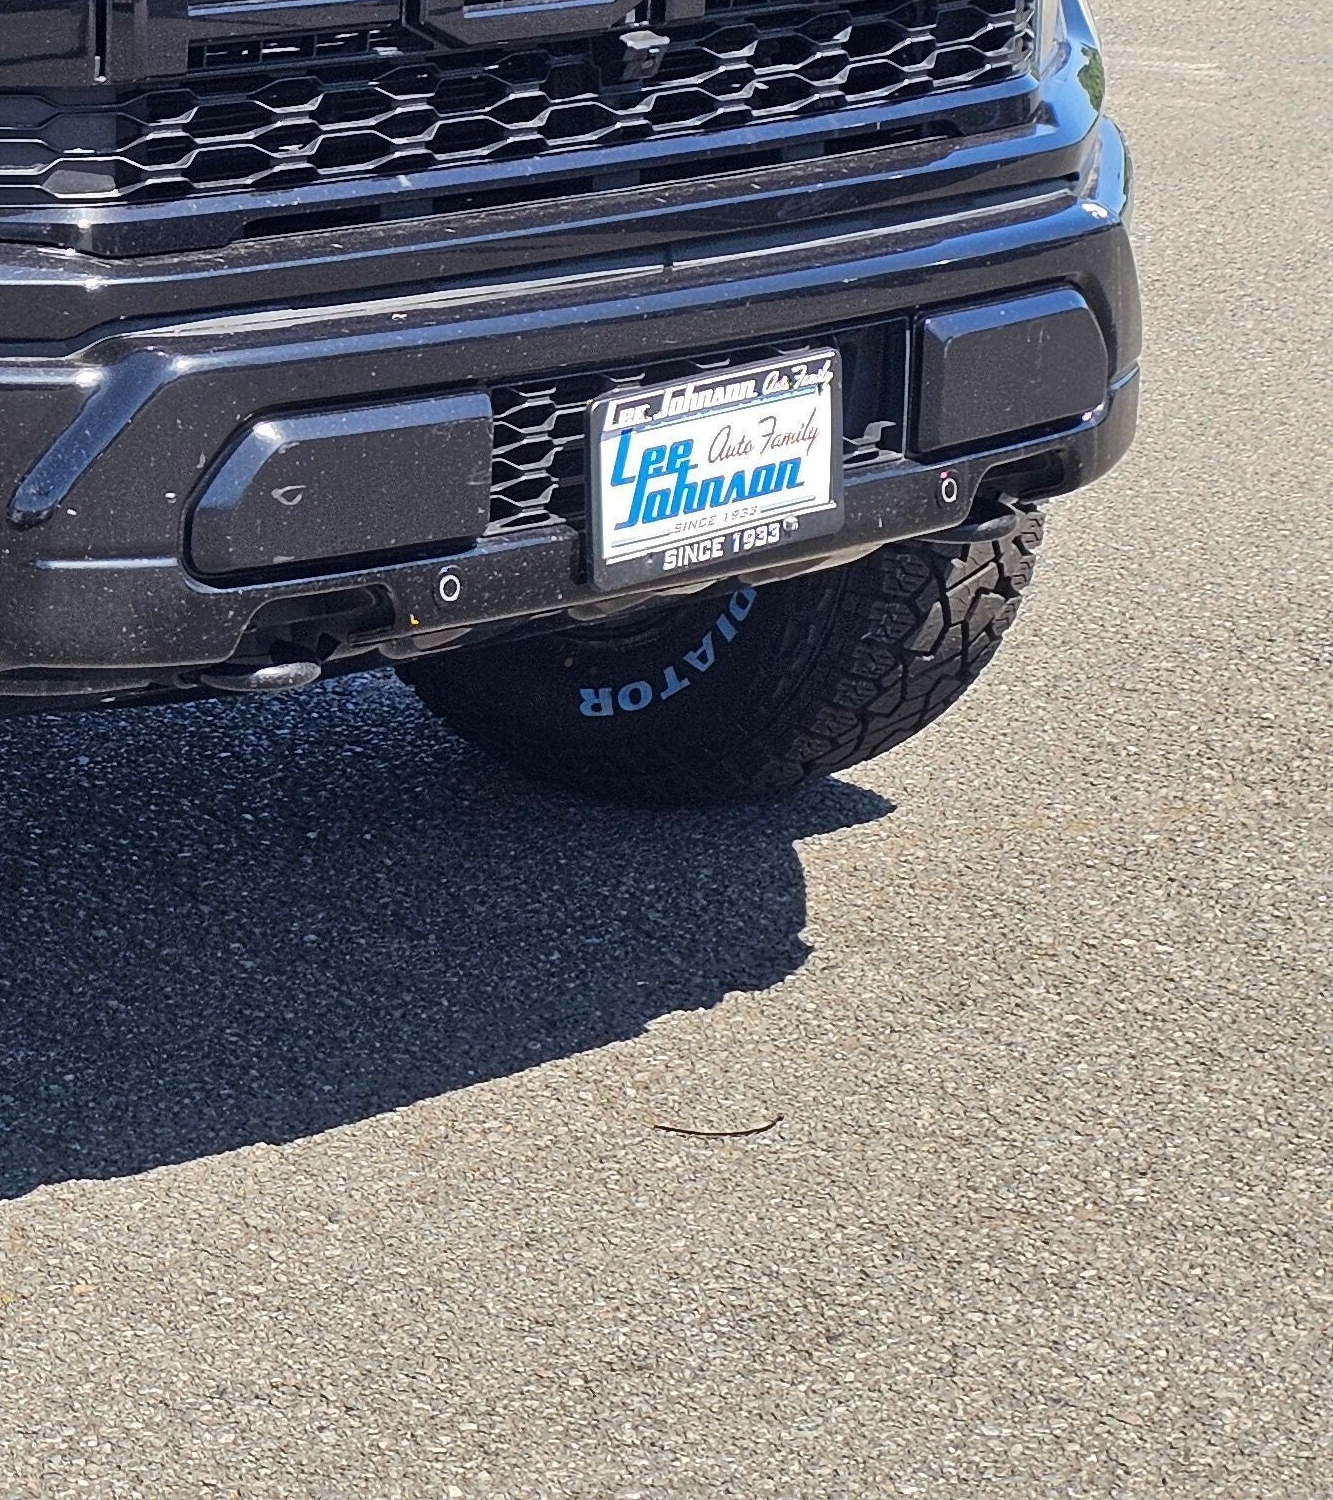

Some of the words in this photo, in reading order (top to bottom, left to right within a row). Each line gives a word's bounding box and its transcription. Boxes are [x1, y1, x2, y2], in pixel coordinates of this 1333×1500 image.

[603, 401, 653, 432] Lee
[654, 380, 757, 421] Johnson
[611, 428, 699, 487] Lee
[708, 424, 755, 463] Auto
[757, 407, 820, 456] Family
[613, 456, 805, 531] Johnson
[662, 535, 725, 571] SINCE
[732, 522, 781, 554] 1933
[673, 514, 718, 533] SINCE
[579, 586, 758, 717] DIATOR
